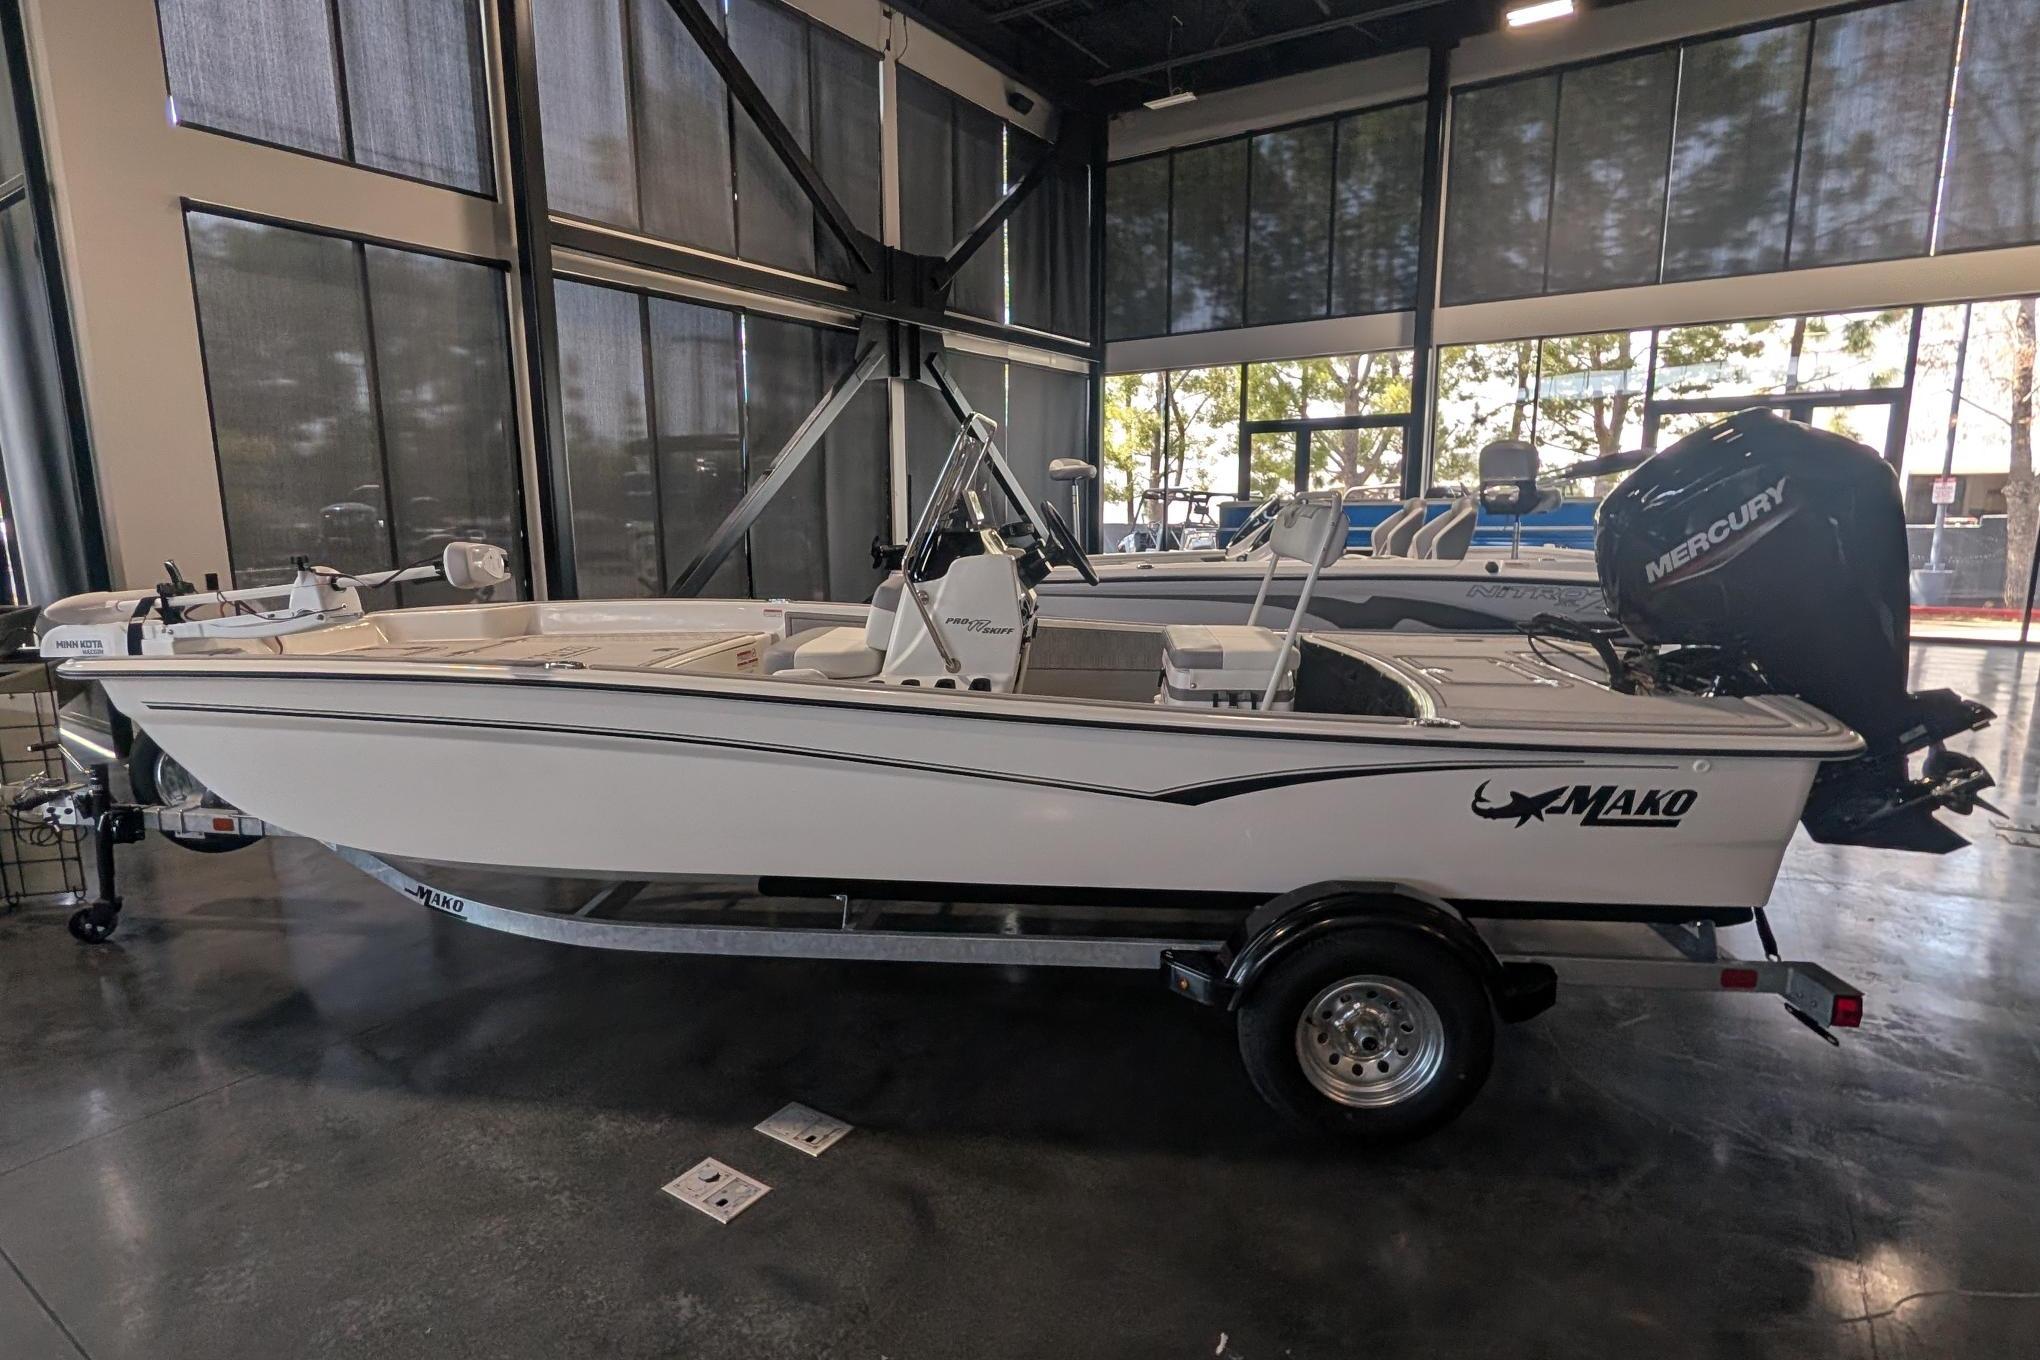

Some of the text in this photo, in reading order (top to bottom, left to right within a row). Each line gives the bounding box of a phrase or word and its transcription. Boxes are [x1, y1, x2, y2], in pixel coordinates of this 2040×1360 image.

[1645, 475, 1788, 584] MERCURY
[56, 639, 103, 649] MINN KOTA
[945, 617, 969, 625] PRO
[981, 627, 1014, 635] SKIFF
[1545, 784, 1698, 828] MAKO
[405, 885, 468, 921] MAKO
